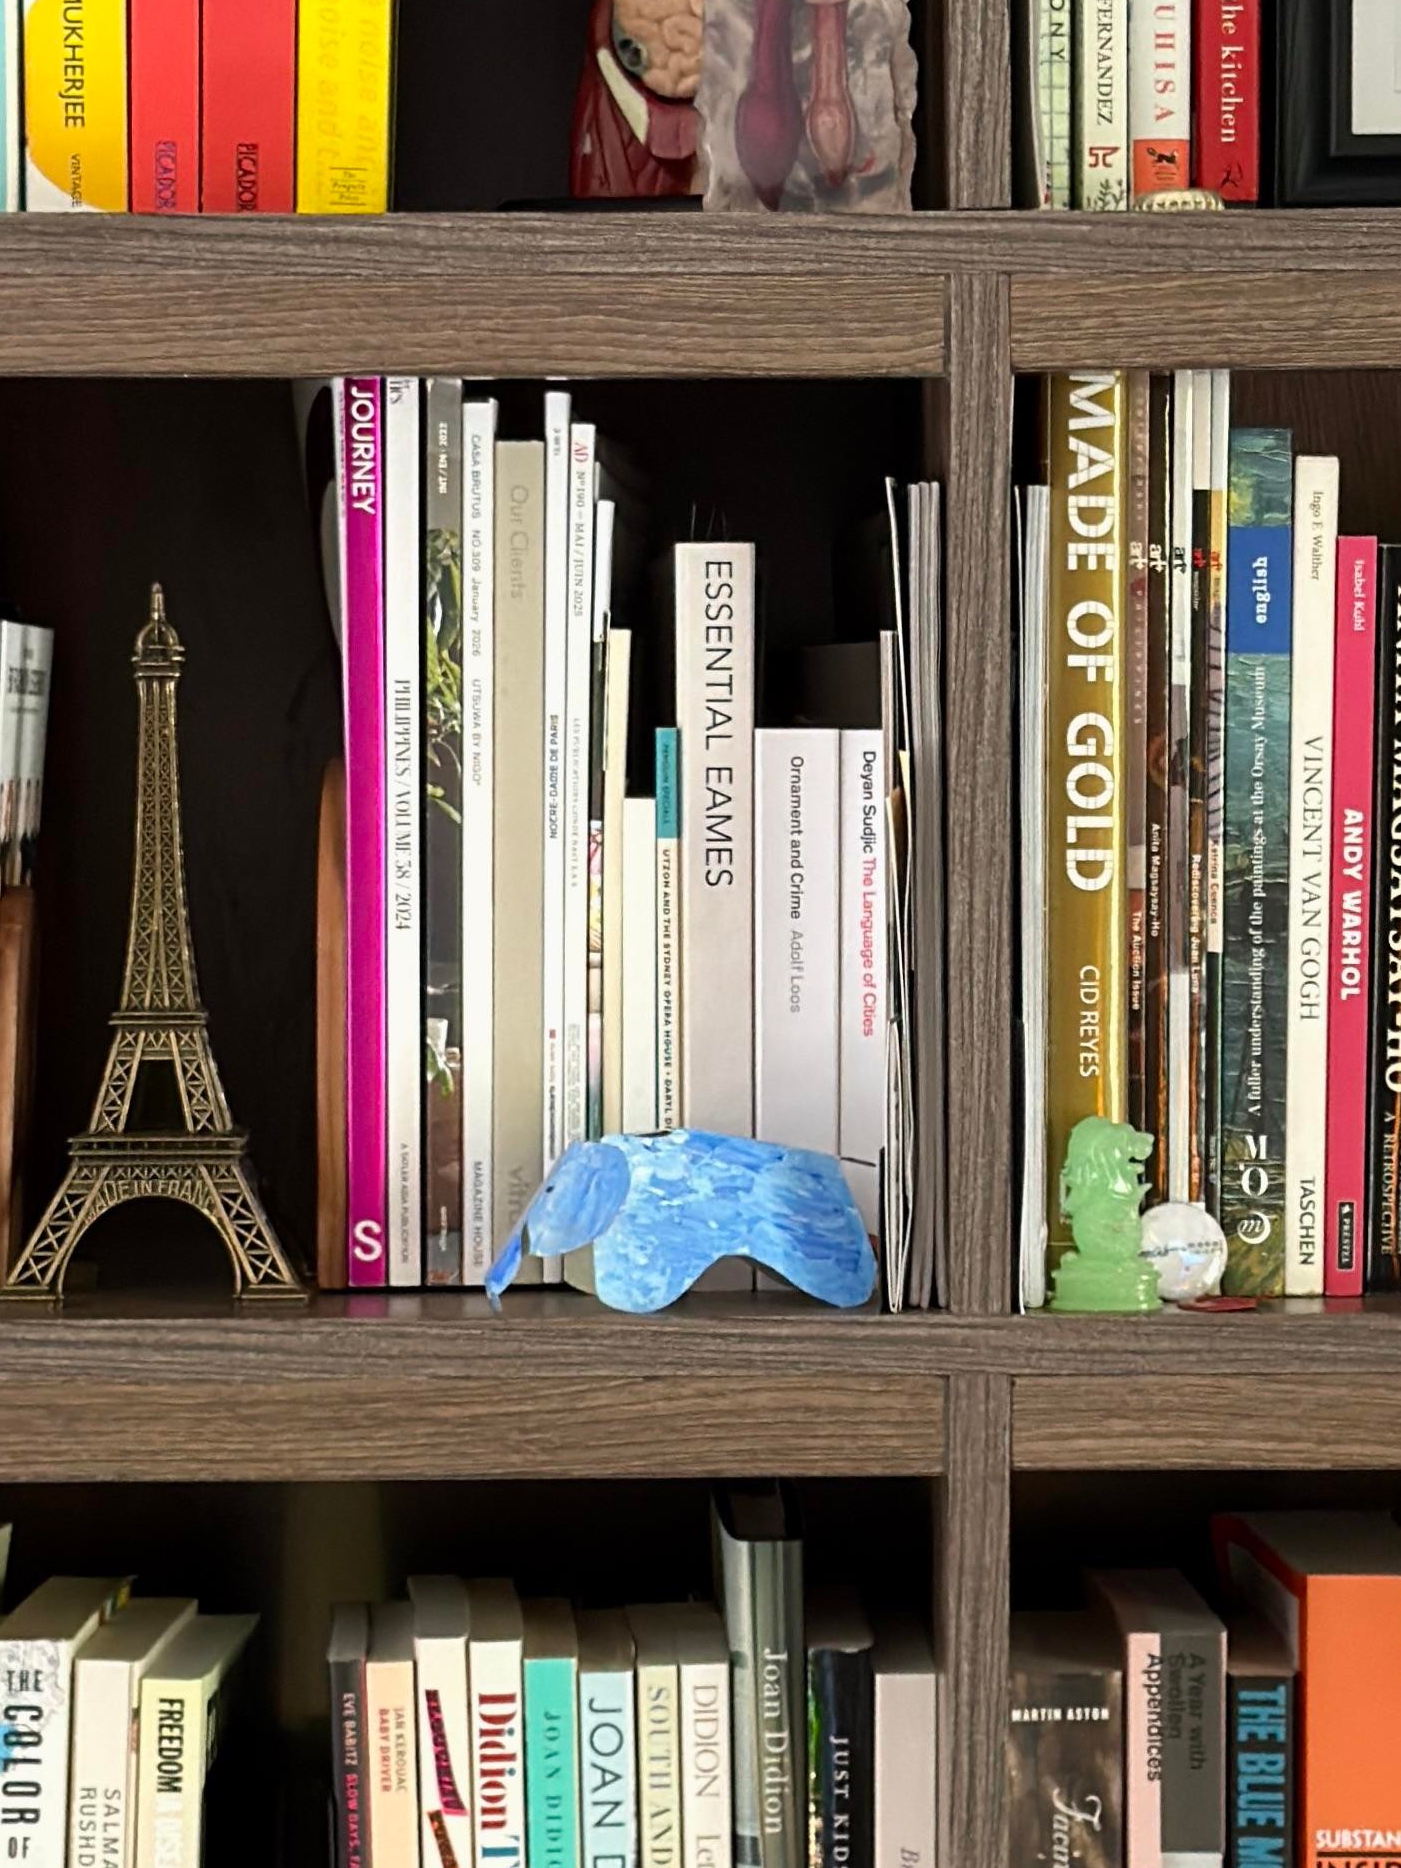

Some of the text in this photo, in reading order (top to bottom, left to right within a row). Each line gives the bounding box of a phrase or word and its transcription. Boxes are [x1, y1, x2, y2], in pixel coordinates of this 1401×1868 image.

[1218, 45, 1244, 146] kitchen
[348, 386, 375, 516] JOURNEY
[705, 560, 733, 888] ESSENTIAL EAMES
[787, 756, 805, 922] Ornament and Crime
[1300, 736, 1325, 1025] VINCENT VAN GOGH
[1340, 809, 1365, 1002] ANDY WARHOL
[1299, 1176, 1317, 1266] TASCHEN
[1, 1703, 41, 1826] COLOR
[156, 1698, 185, 1794] FREEDOM
[478, 1692, 517, 1831] Didion
[589, 1696, 621, 1832] JOAN
